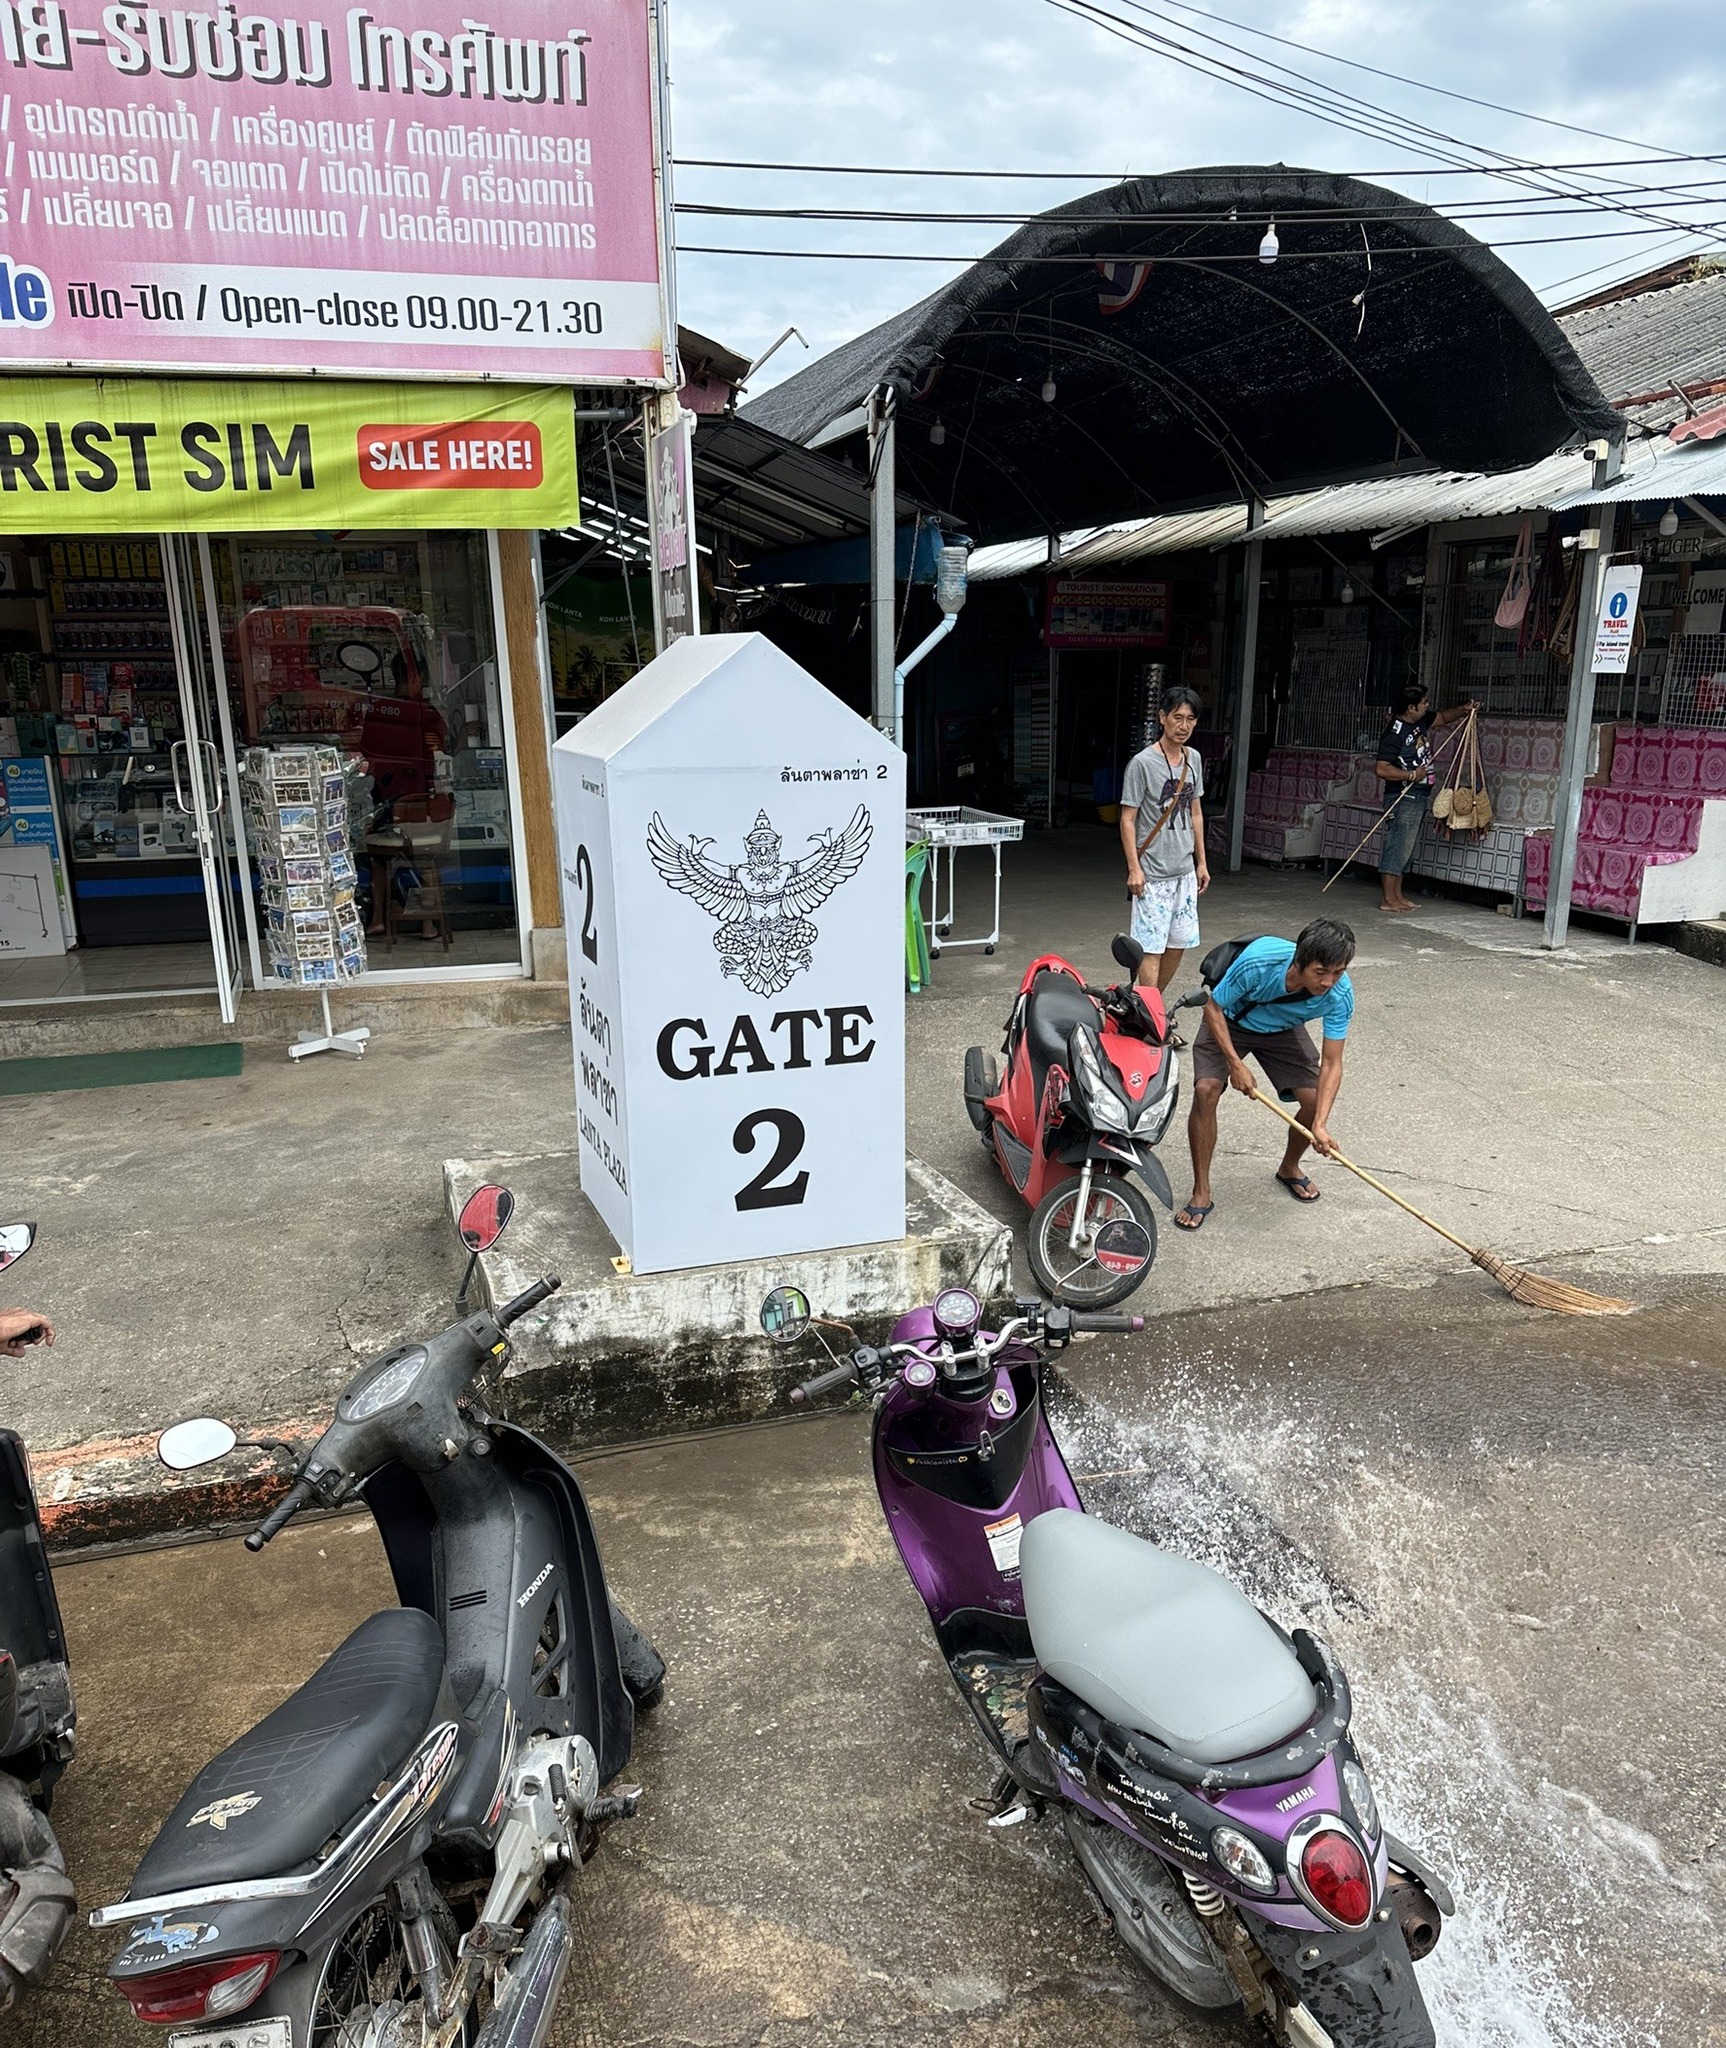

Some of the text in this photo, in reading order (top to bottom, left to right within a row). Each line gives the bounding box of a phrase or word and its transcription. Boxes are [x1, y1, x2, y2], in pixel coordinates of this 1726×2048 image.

[347, 8, 592, 106] โทรศัพท์
[24, 99, 200, 140] อุปกรณ์ดำน้ำ
[232, 105, 375, 155] เครื่องศูนย์
[406, 121, 592, 165] ตัดฟิล์มกันรอย
[28, 149, 160, 185] เมนบอร์ด
[192, 159, 288, 191] จอแตก
[319, 161, 431, 199] เปิดไม่ติด
[43, 186, 174, 230] เปลี่ยนจอ
[206, 194, 347, 238] เปลี่ยนแบต
[380, 206, 597, 251] ปลดล็อกทุกอาการ
[68, 282, 184, 321] เปิด-ปิด
[220, 287, 399, 328] Open-close
[406, 294, 603, 334] 09.00-21.30
[0, 421, 315, 492] RIST SIM
[370, 439, 533, 471] SALE HERE!
[658, 523, 687, 577] Repair
[1660, 537, 1701, 557] TIGER
[664, 589, 686, 620] Mobile
[1066, 583, 1157, 593] TOURIST INFORMATION
[1672, 588, 1725, 605] WELCOME
[1603, 619, 1628, 628] TRAVEL
[780, 759, 888, 783] ลันตาพลาซ่า 2
[577, 843, 598, 966] 2
[656, 1005, 876, 1080] GATE
[579, 1108, 628, 1196] LANTA PLAZA
[733, 1108, 810, 1212] 2
[516, 1562, 554, 1608] HONDA
[1275, 1785, 1317, 1814] YAMAHA
